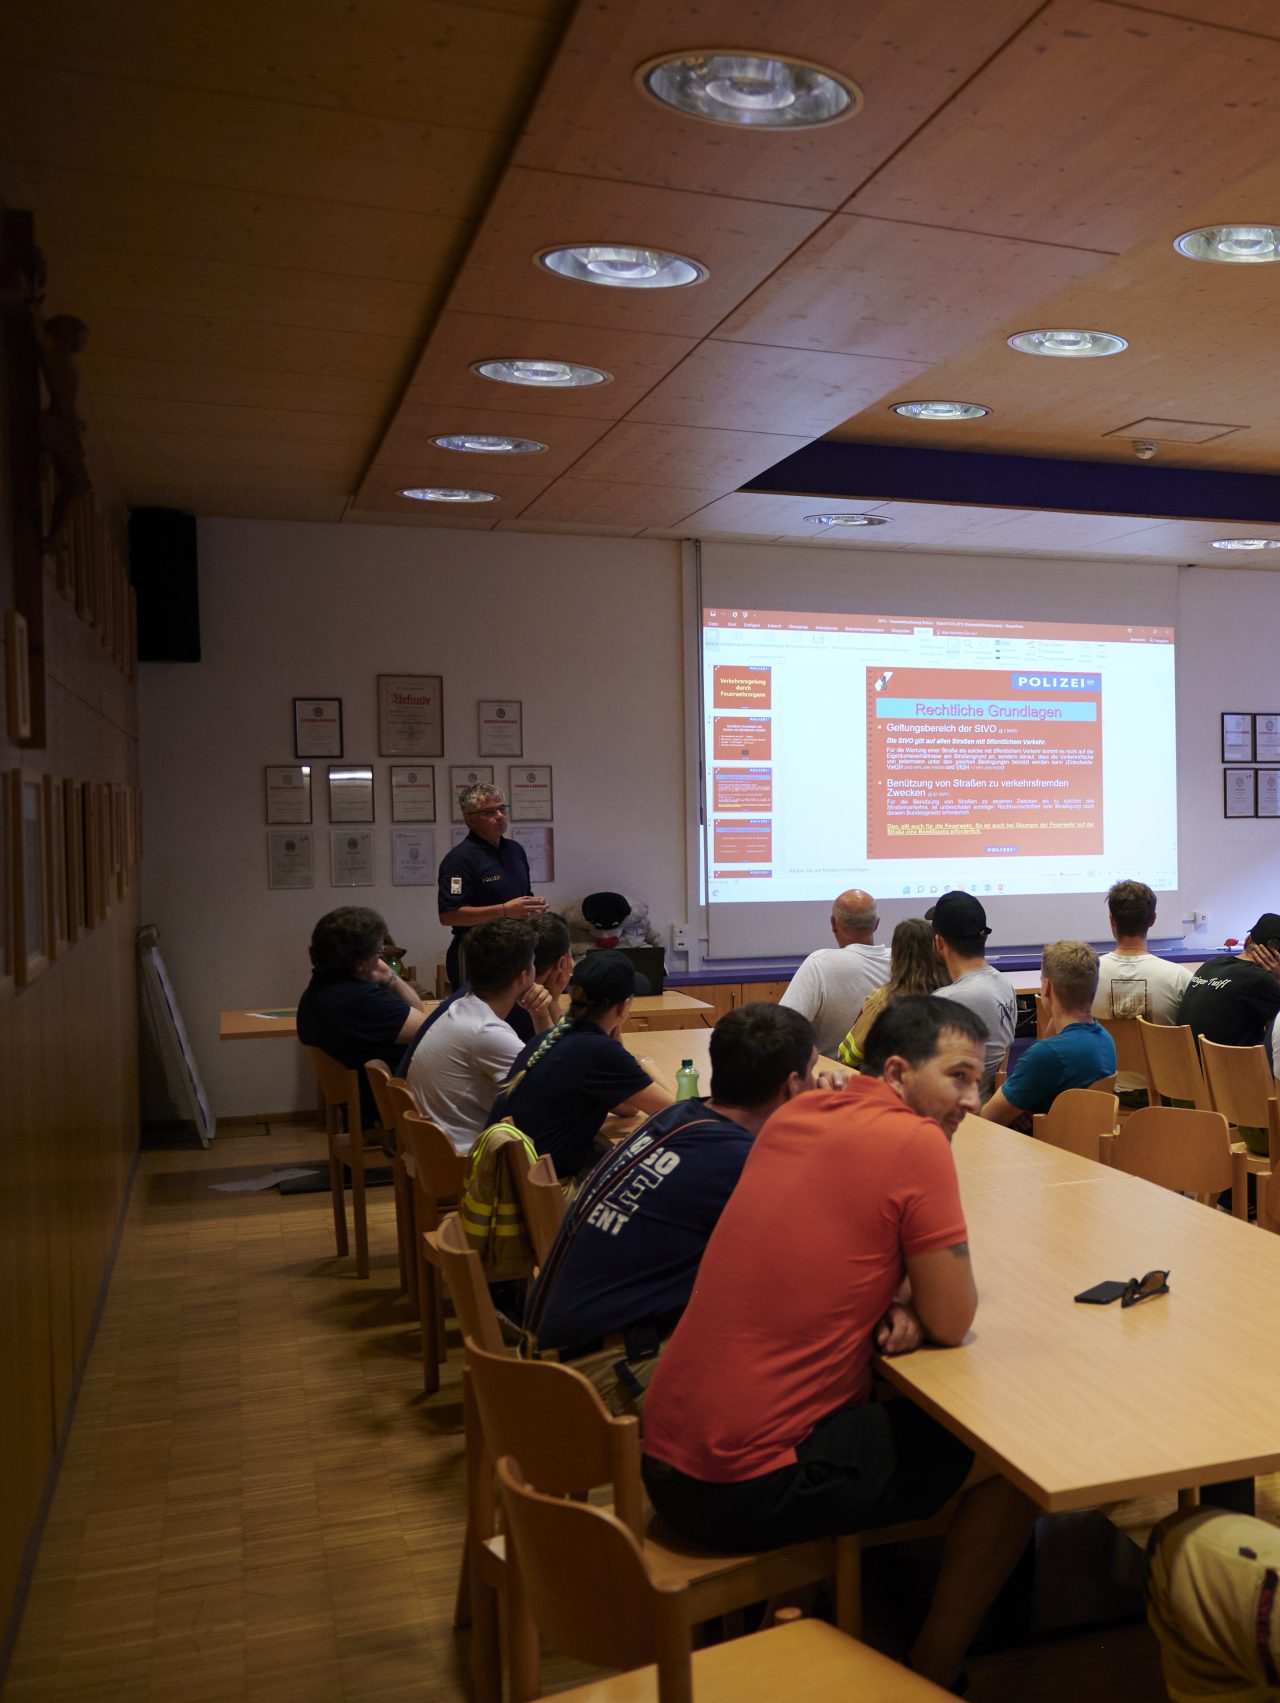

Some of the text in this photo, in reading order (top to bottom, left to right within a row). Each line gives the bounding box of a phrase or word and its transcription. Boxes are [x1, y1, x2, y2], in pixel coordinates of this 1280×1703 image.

[1018, 676, 1084, 688] POLIZEI
[915, 704, 1062, 720] Rechtliche Grundlagen
[886, 723, 956, 734] Geltungsbereich
[959, 724, 972, 732] der
[974, 724, 997, 733] StVO
[887, 778, 1069, 789] Benützung von Straßen zu verkehrsfremden
[887, 788, 926, 797] Zwecken
